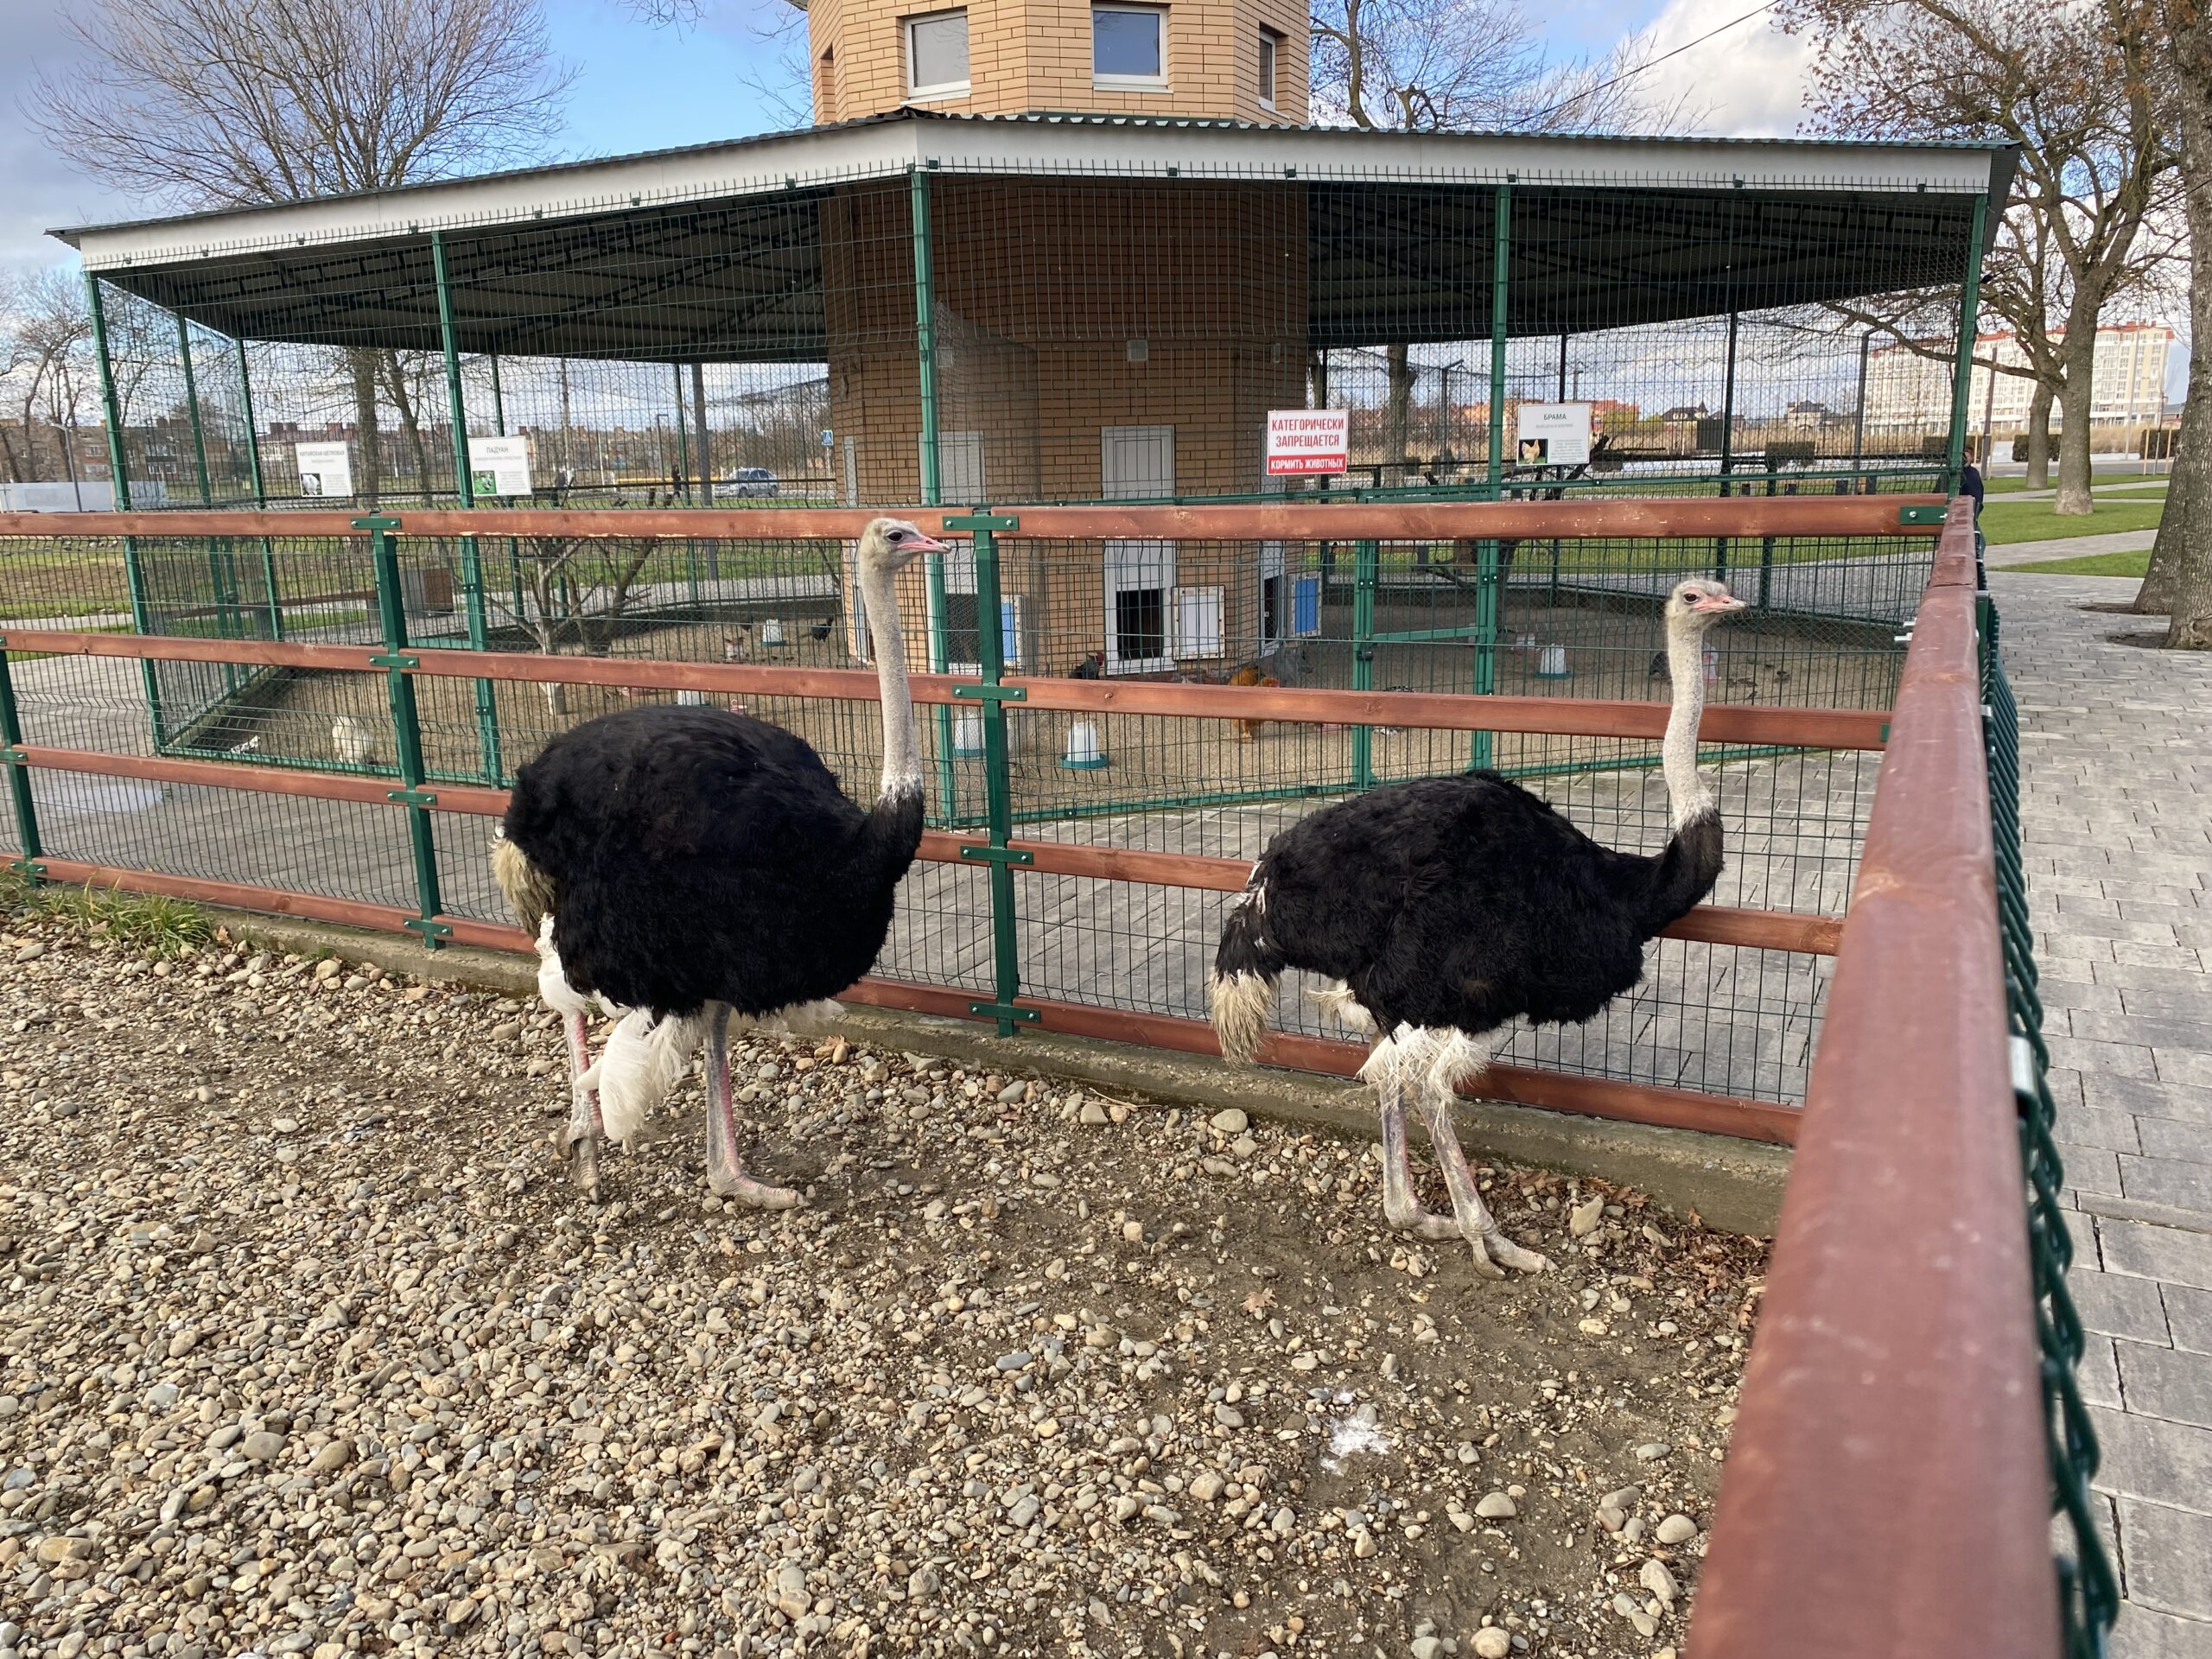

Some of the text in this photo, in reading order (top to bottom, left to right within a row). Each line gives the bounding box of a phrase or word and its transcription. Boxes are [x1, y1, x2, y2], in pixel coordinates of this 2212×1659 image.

[1272, 418, 1344, 431] КАТЕГОРИЧЕСКИ
[1276, 434, 1339, 448] ЗАПРЕЩАЕТСЯ
[1271, 458, 1344, 470] КОРМИТЬ ЖИВОТНЫХ
